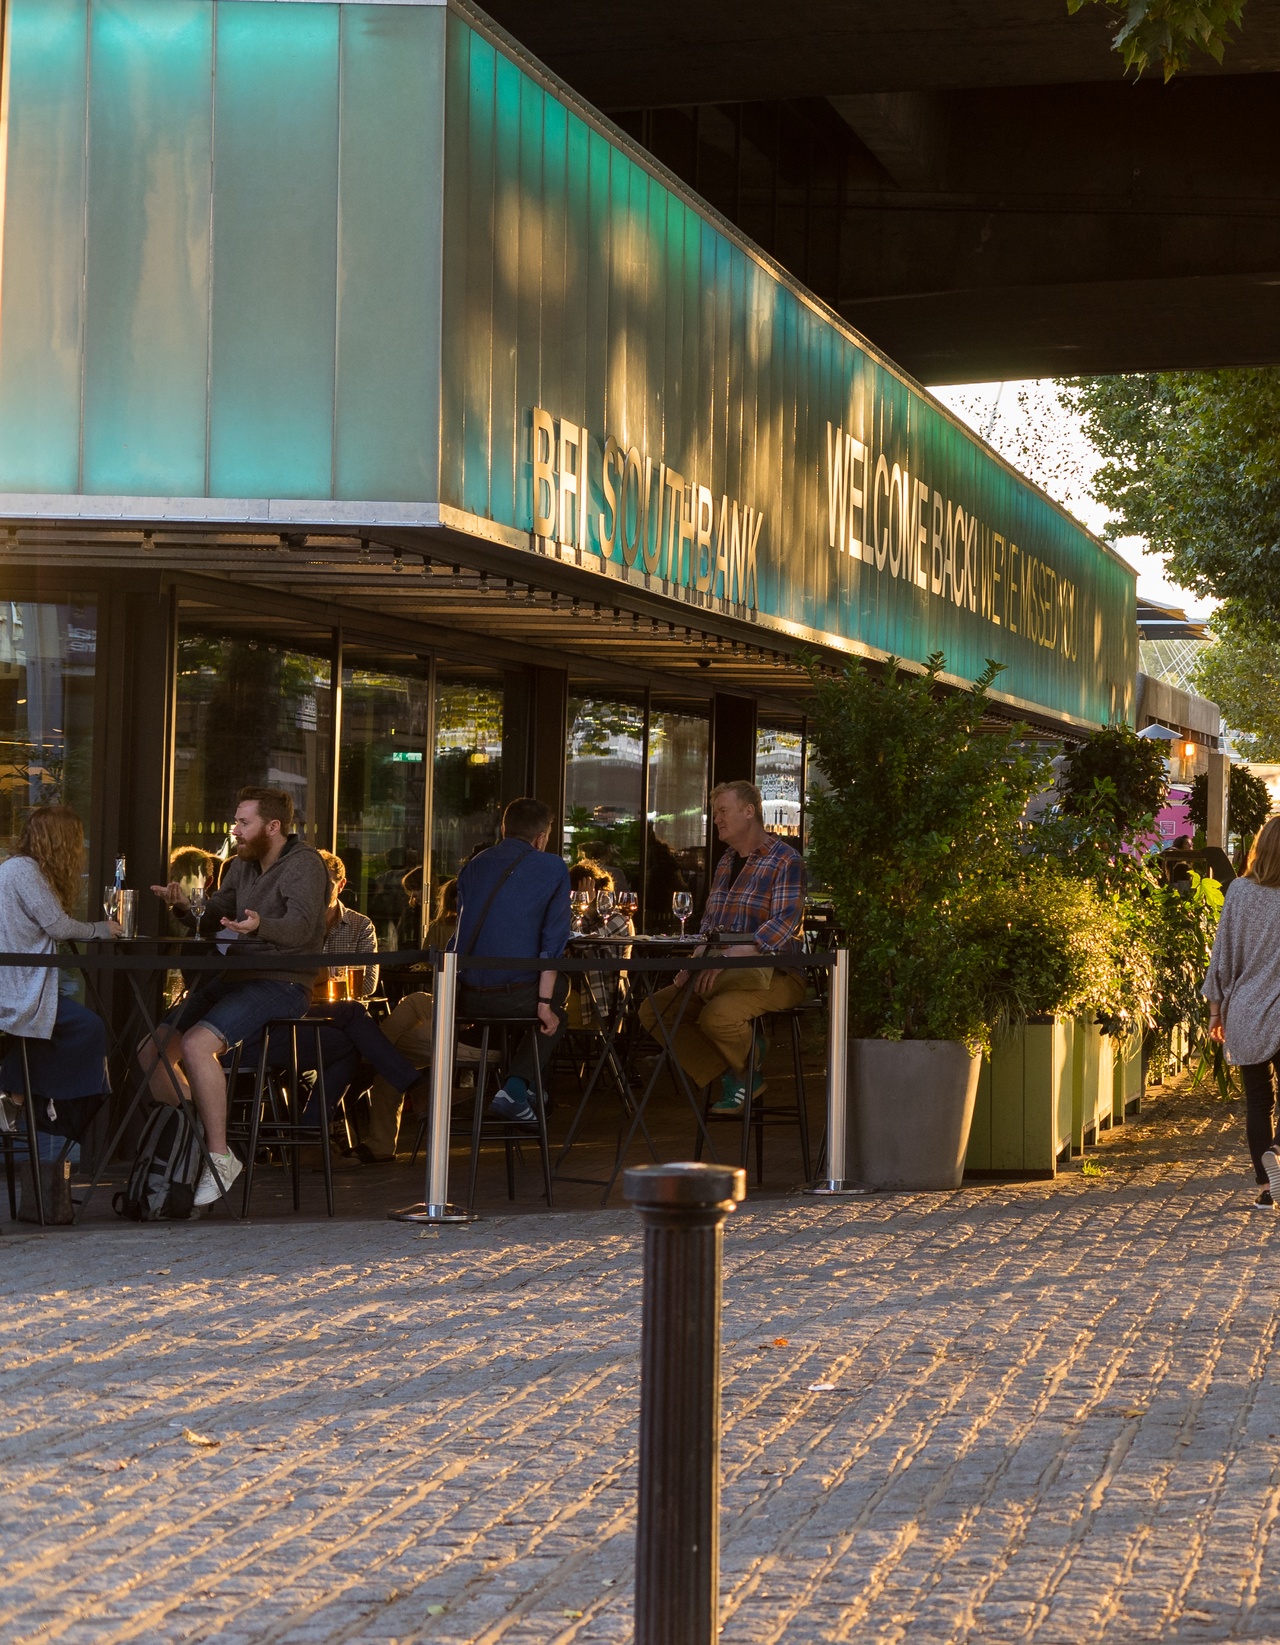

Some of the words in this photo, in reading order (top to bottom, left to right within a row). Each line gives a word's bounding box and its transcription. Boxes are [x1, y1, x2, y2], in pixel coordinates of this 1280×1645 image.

[533, 406, 588, 551] BFI
[599, 434, 764, 611] SOUTHBANK
[827, 421, 929, 590] WELCOME
[931, 490, 978, 613] BACK!
[981, 523, 1018, 633] WE'VE
[1019, 550, 1057, 650] MISSED
[1058, 572, 1079, 662] YOU
